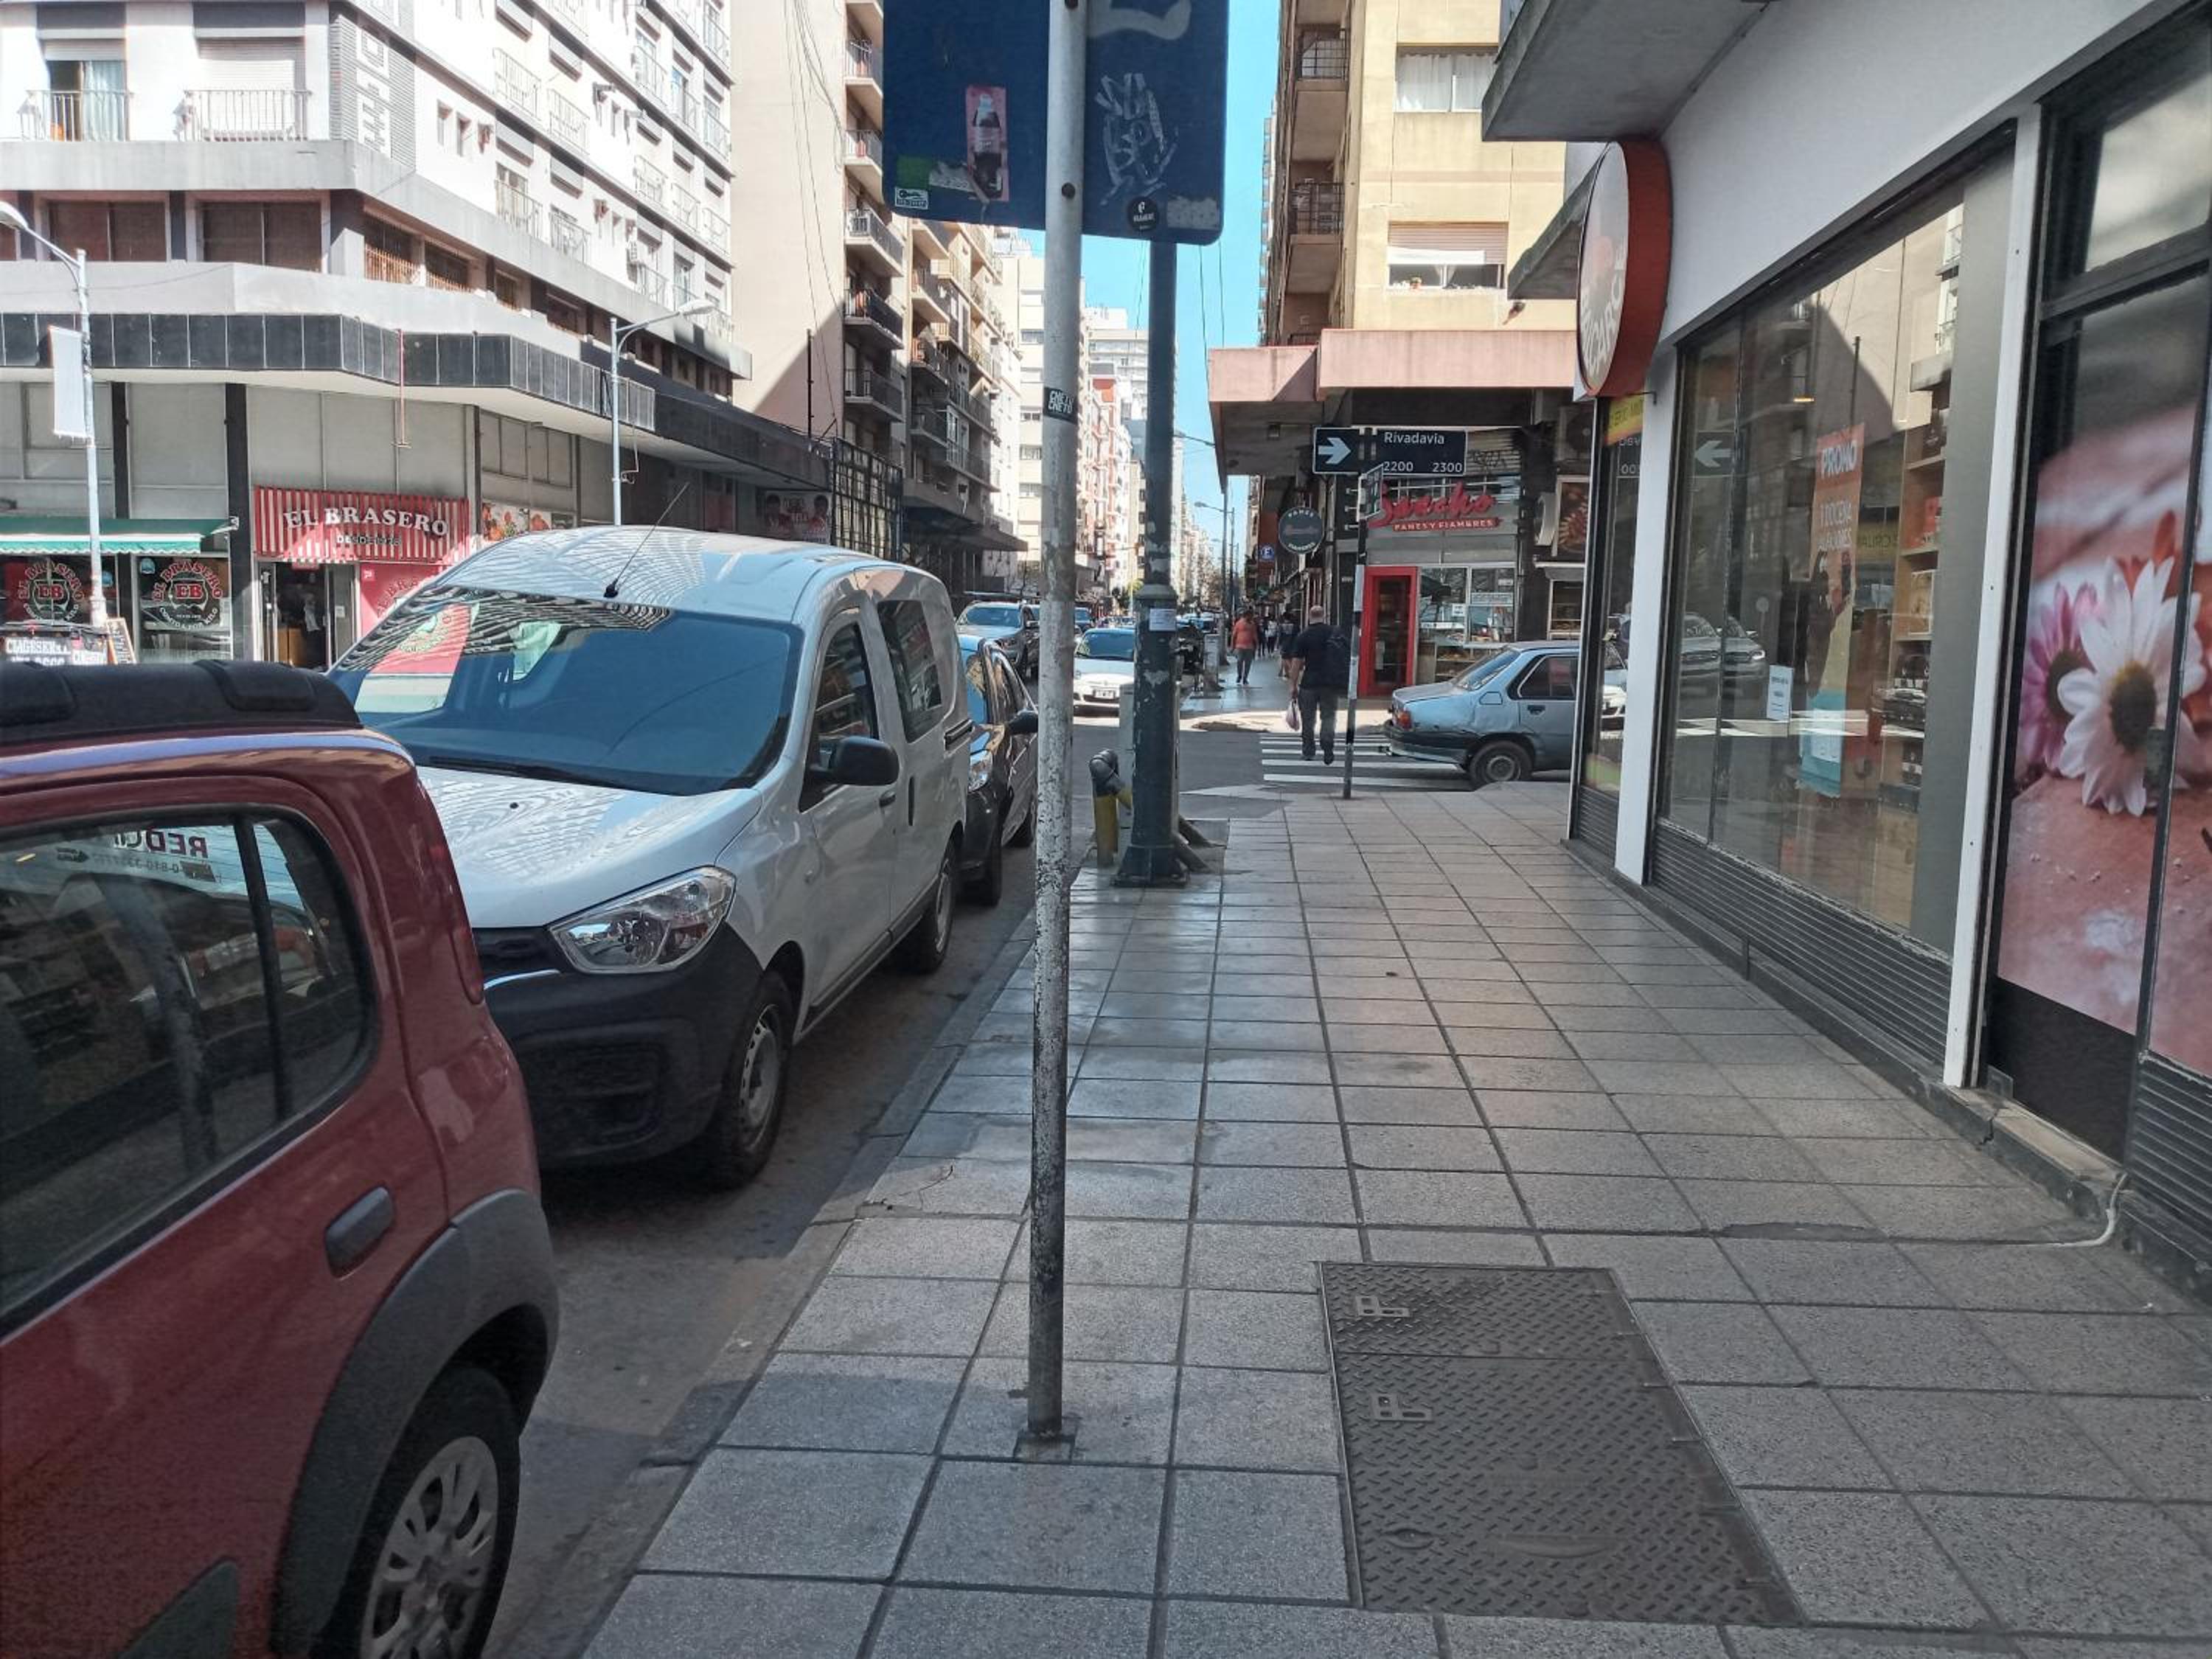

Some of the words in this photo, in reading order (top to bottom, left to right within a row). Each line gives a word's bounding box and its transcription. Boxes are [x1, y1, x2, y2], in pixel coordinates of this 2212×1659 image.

[1384, 431, 1444, 445] Rivadavia
[1383, 461, 1413, 471] 2200
[1432, 462, 1462, 473] 2300
[1822, 440, 1857, 478] PROMO
[283, 509, 319, 529] EL
[324, 507, 449, 536] BRASERO
[1439, 519, 1494, 529] FIAMBRES
[160, 560, 223, 599] BRASERO
[174, 583, 204, 599] EB
